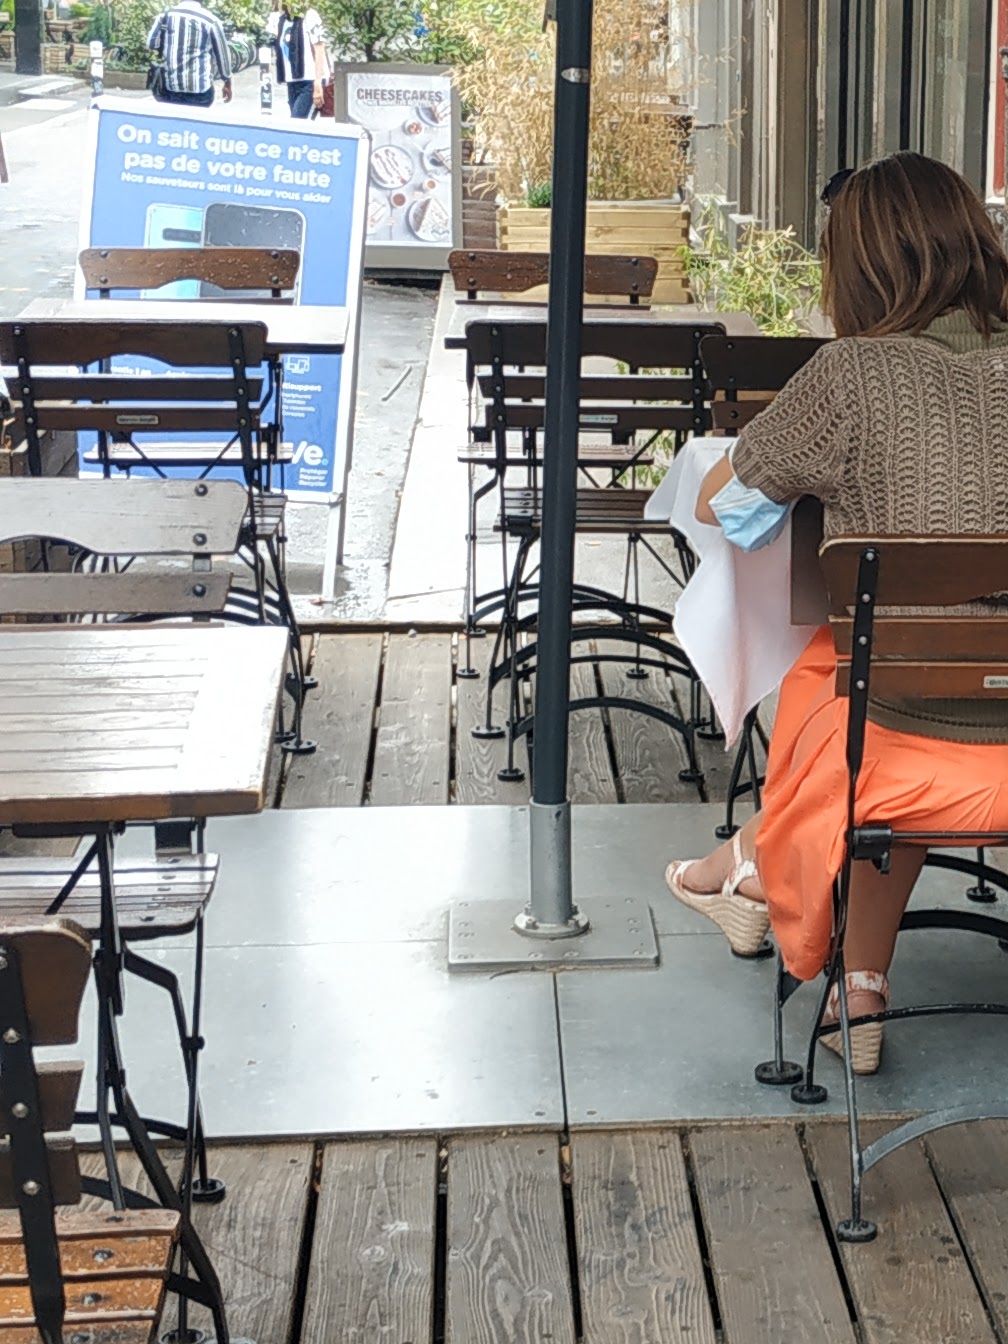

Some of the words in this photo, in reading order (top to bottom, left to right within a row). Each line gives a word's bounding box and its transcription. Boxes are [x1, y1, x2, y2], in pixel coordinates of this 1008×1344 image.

[356, 88, 443, 103] CHEESECAKES
[117, 123, 152, 144] On
[157, 130, 199, 150] sait
[205, 137, 249, 155] que
[254, 143, 282, 159] ce
[287, 144, 342, 166] n'est
[121, 171, 144, 183] Nos
[207, 182, 231, 193] sont
[245, 187, 273, 197] pour
[275, 189, 301, 201] vous
[302, 193, 332, 203] aider
[124, 152, 166, 170] pas
[171, 154, 201, 174] de
[207, 161, 267, 181] votre
[273, 164, 331, 188] faute
